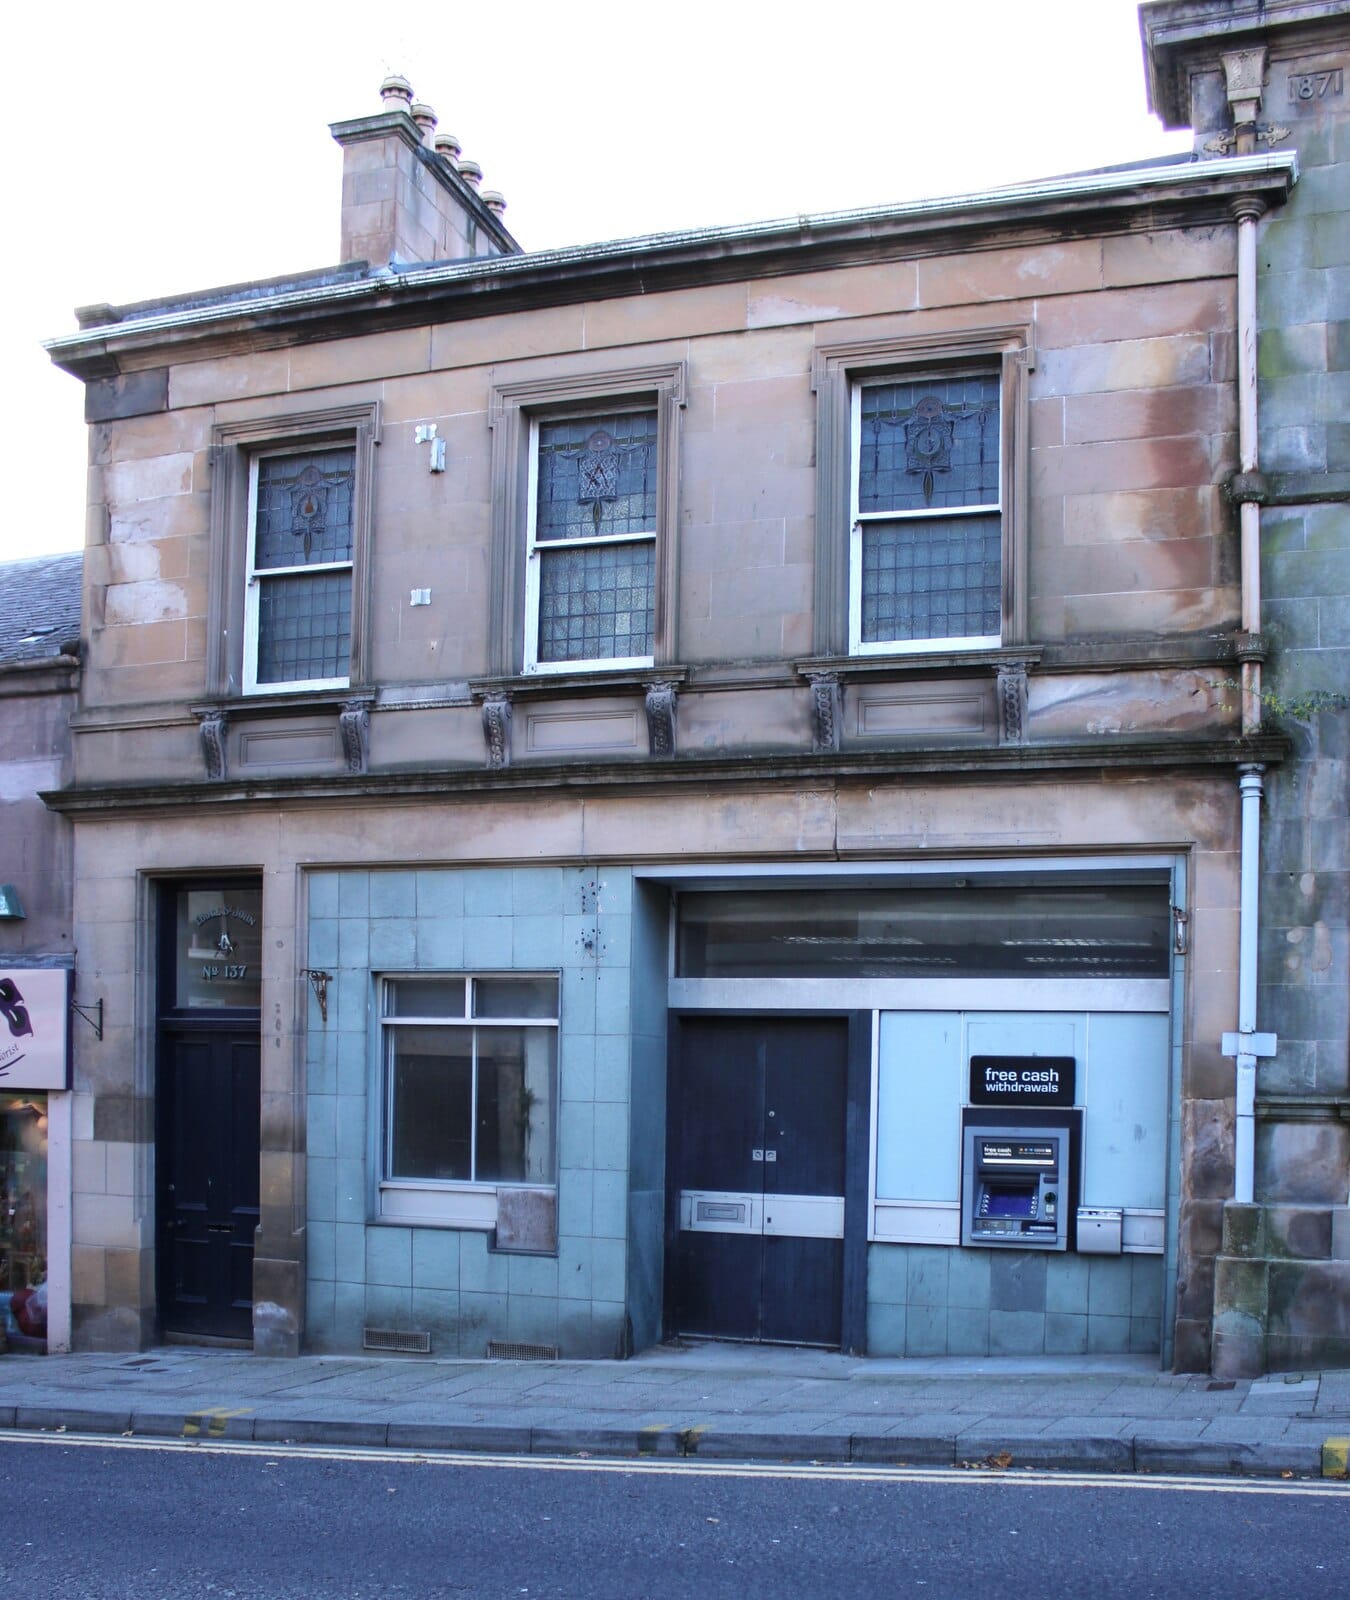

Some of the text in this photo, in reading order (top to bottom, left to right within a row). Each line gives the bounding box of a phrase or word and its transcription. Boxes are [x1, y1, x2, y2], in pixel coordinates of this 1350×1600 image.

[1290, 70, 1342, 101] 1871
[224, 964, 246, 978] 137
[985, 1067, 1059, 1082] free cash
[985, 1081, 1059, 1093] withdrawals
